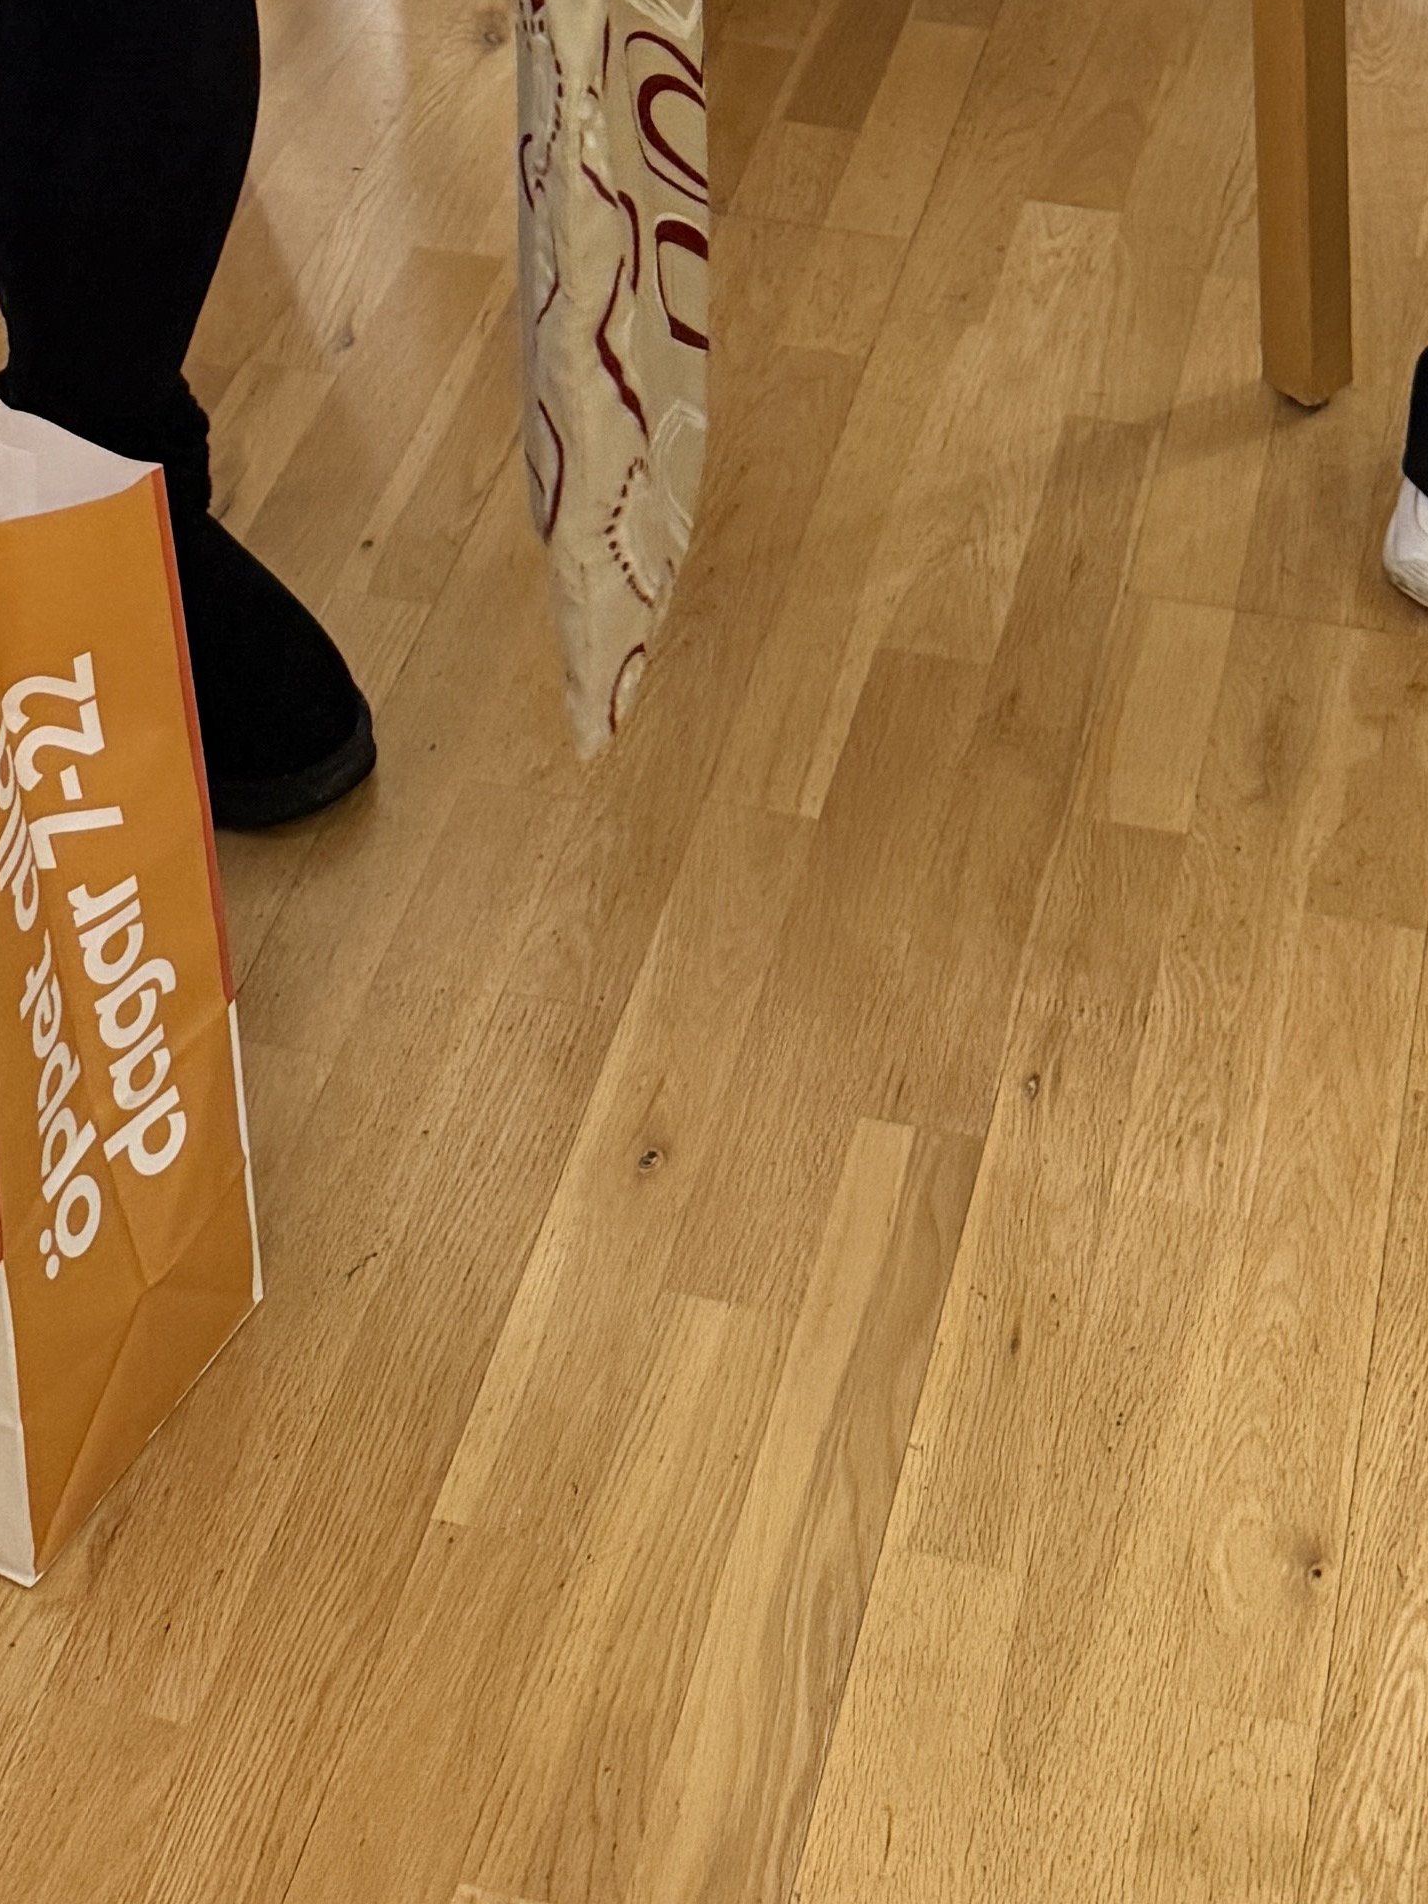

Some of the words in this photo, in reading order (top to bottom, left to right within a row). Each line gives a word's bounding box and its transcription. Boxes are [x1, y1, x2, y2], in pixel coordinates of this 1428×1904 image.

[1, 651, 125, 869] 7-22
[20, 928, 102, 1280] öppet
[67, 874, 188, 1176] dagar
